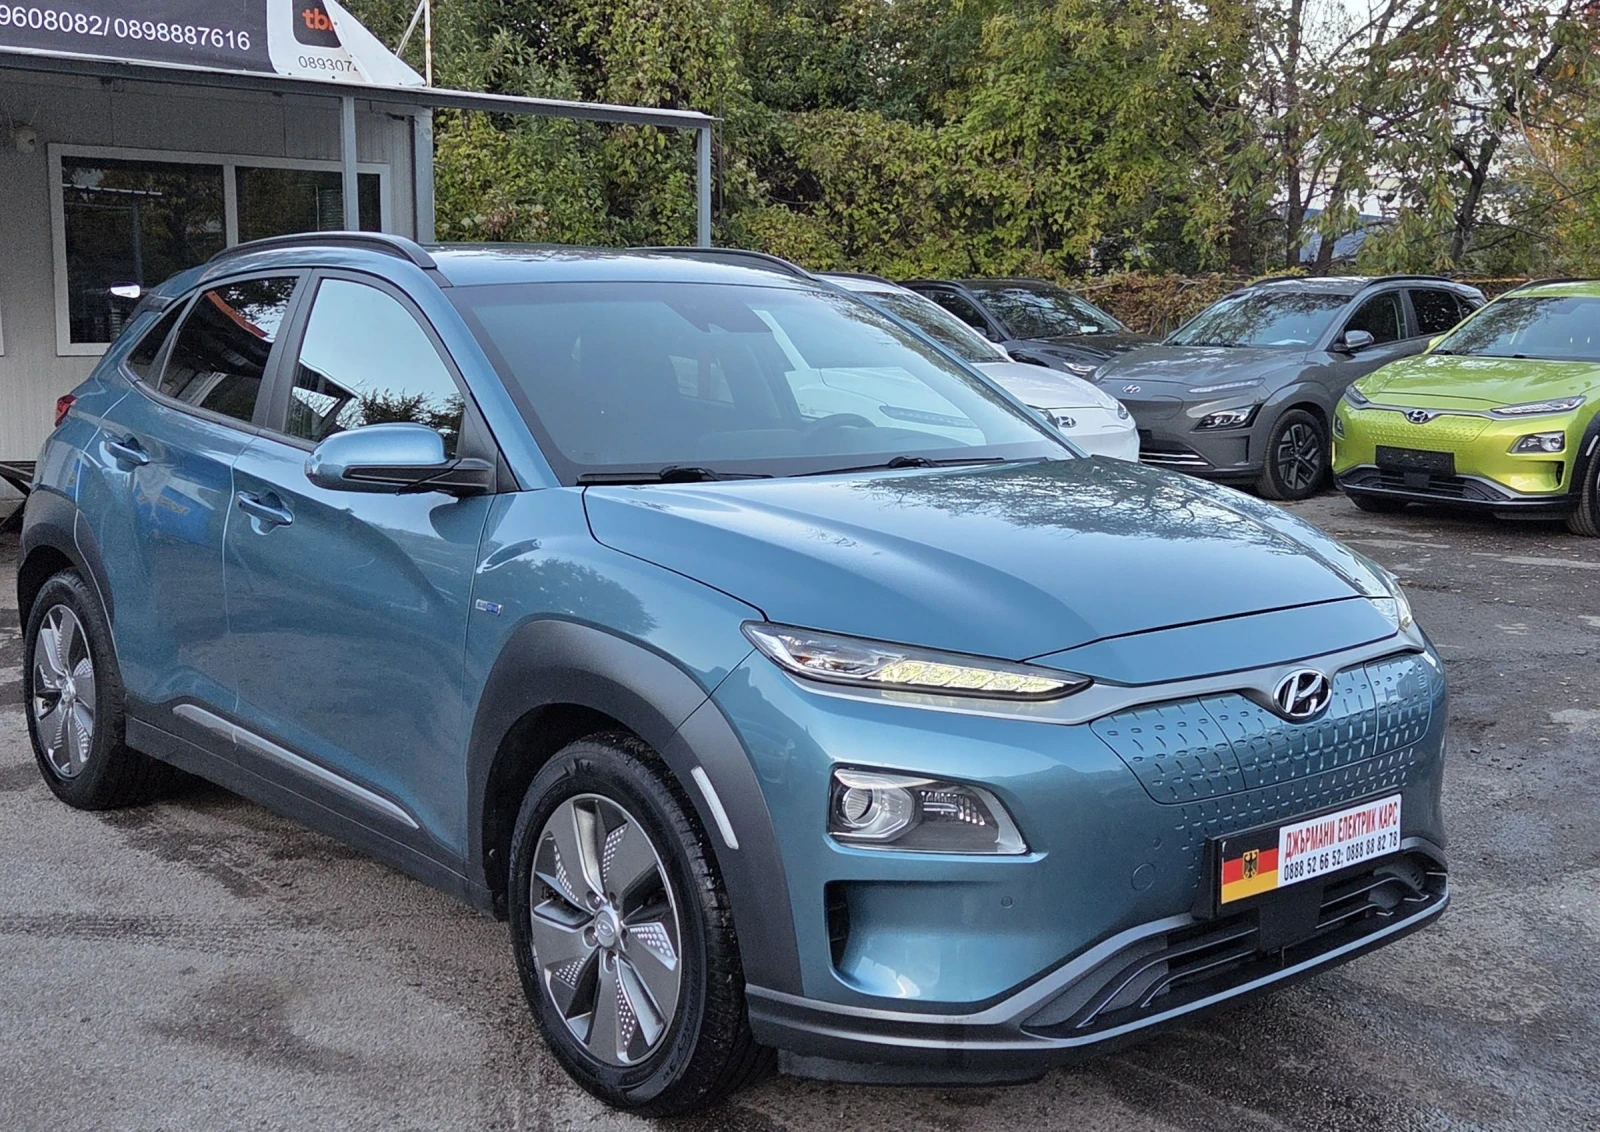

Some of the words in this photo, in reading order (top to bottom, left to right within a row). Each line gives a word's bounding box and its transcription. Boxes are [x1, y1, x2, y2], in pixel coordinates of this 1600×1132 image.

[302, 8, 333, 31] tb
[298, 56, 358, 72] 089307
[1285, 820, 1336, 863] ДЖЪРМАНИ
[1338, 808, 1377, 843] ЕЛЕКТРИК
[1379, 802, 1398, 830] КАРС
[1284, 860, 1304, 881] 0888
[1307, 856, 1317, 875] 52
[1320, 852, 1329, 871] 66
[1346, 841, 1364, 862] 0888
[1366, 838, 1375, 855] 88
[1377, 834, 1386, 852] 82
[1389, 831, 1398, 848] 78
